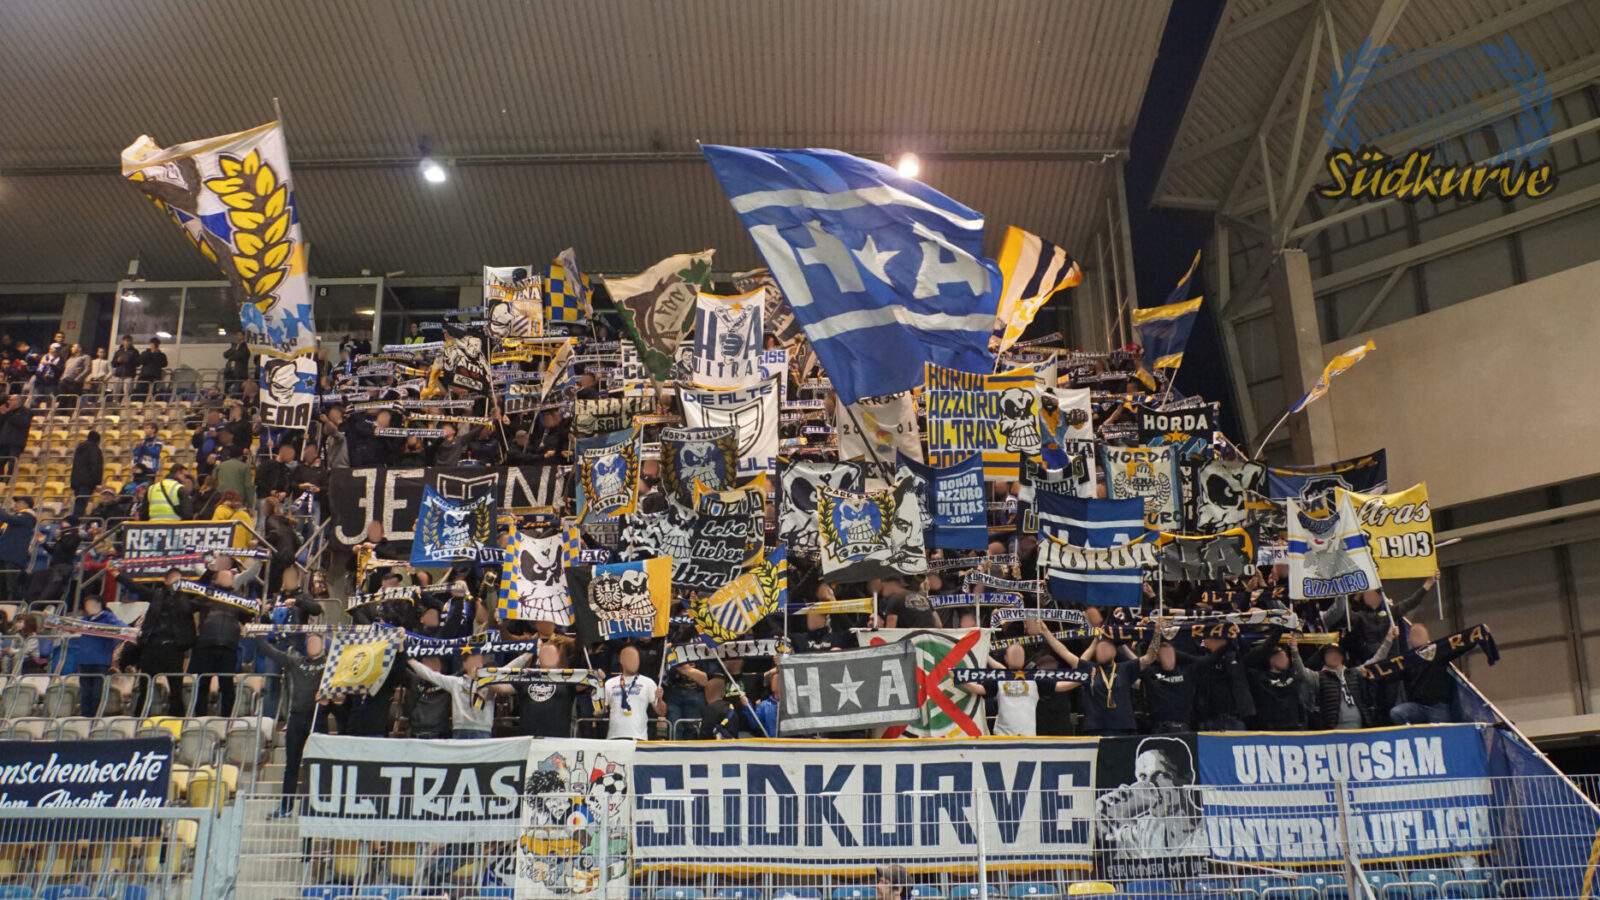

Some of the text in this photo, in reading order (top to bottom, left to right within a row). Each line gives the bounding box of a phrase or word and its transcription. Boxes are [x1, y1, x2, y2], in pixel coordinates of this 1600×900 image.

[719, 384, 773, 404] ALTE
[929, 390, 1000, 419] AZZURO
[1144, 414, 1209, 432] HORDA
[929, 419, 998, 449] ULTRAS
[1108, 449, 1171, 463] HORDA
[939, 472, 979, 491] HORDA
[937, 486, 983, 502] AZZURO
[937, 500, 984, 516] ULTRAS
[126, 528, 232, 549] REFUGEES
[1377, 531, 1433, 558] 1903
[691, 539, 745, 563] lieber
[1037, 538, 1159, 570] HORDA
[181, 581, 206, 594] NICO
[407, 644, 454, 658] Horda
[675, 638, 778, 664] HORDA
[957, 669, 1006, 682] Horda
[1231, 736, 1447, 785] UNBEUGSAM
[310, 763, 521, 818] ULTRAS
[632, 759, 1092, 848] SÜDKURVE
